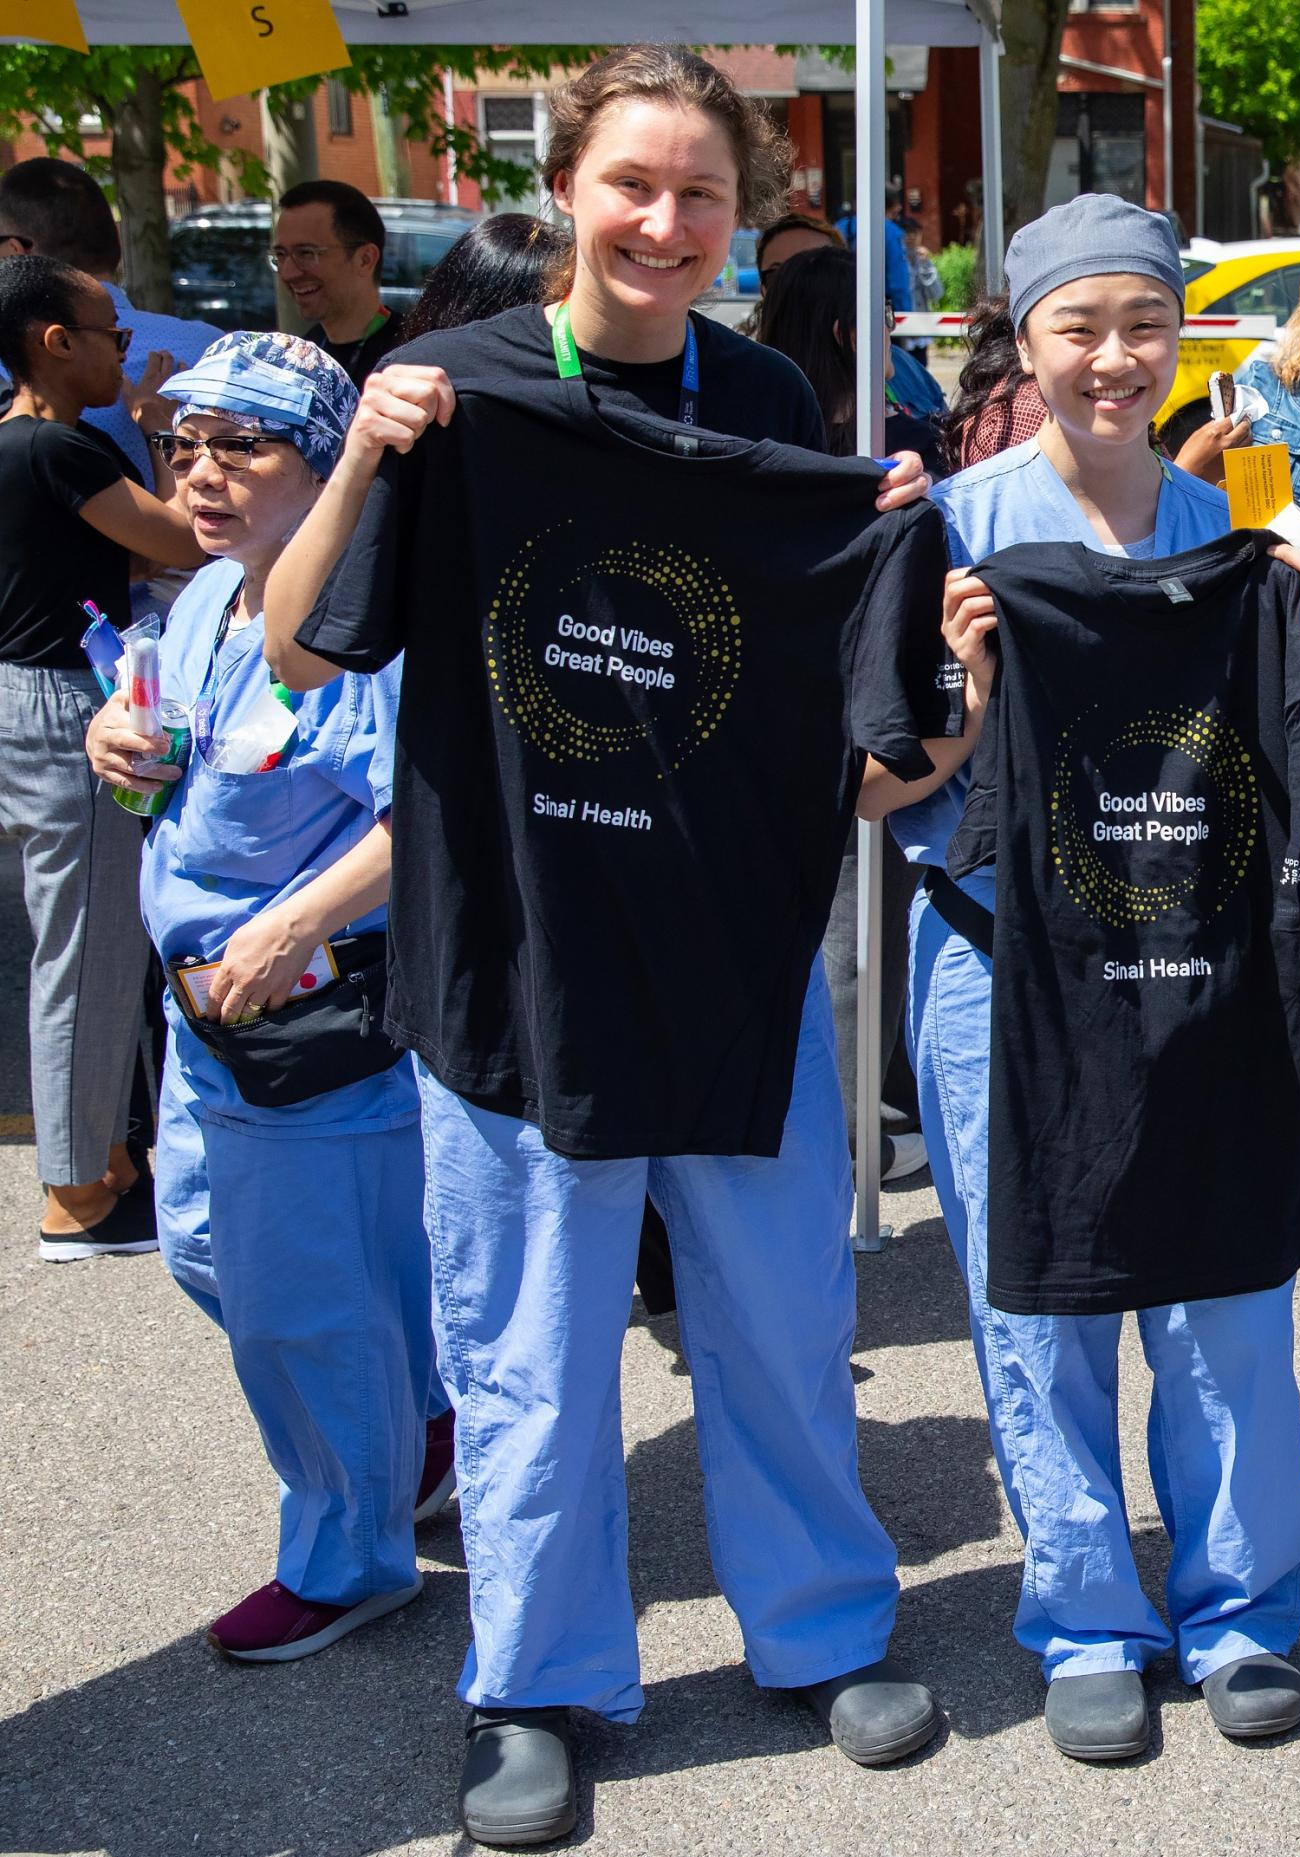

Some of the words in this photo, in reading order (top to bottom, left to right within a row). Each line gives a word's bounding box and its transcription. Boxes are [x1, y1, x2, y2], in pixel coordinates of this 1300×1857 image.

[251, 6, 274, 37] S
[558, 614, 616, 647] Good
[620, 627, 674, 659] Vibes
[545, 643, 603, 674] Great
[606, 655, 675, 690] People
[533, 793, 576, 819] Sinai
[581, 801, 652, 830] Health
[1100, 791, 1147, 813] Good
[1151, 791, 1206, 813] Vibes
[1093, 820, 1142, 841] Great
[1146, 820, 1210, 846] People
[1103, 959, 1144, 980] Sinai
[1149, 957, 1212, 978] Health
